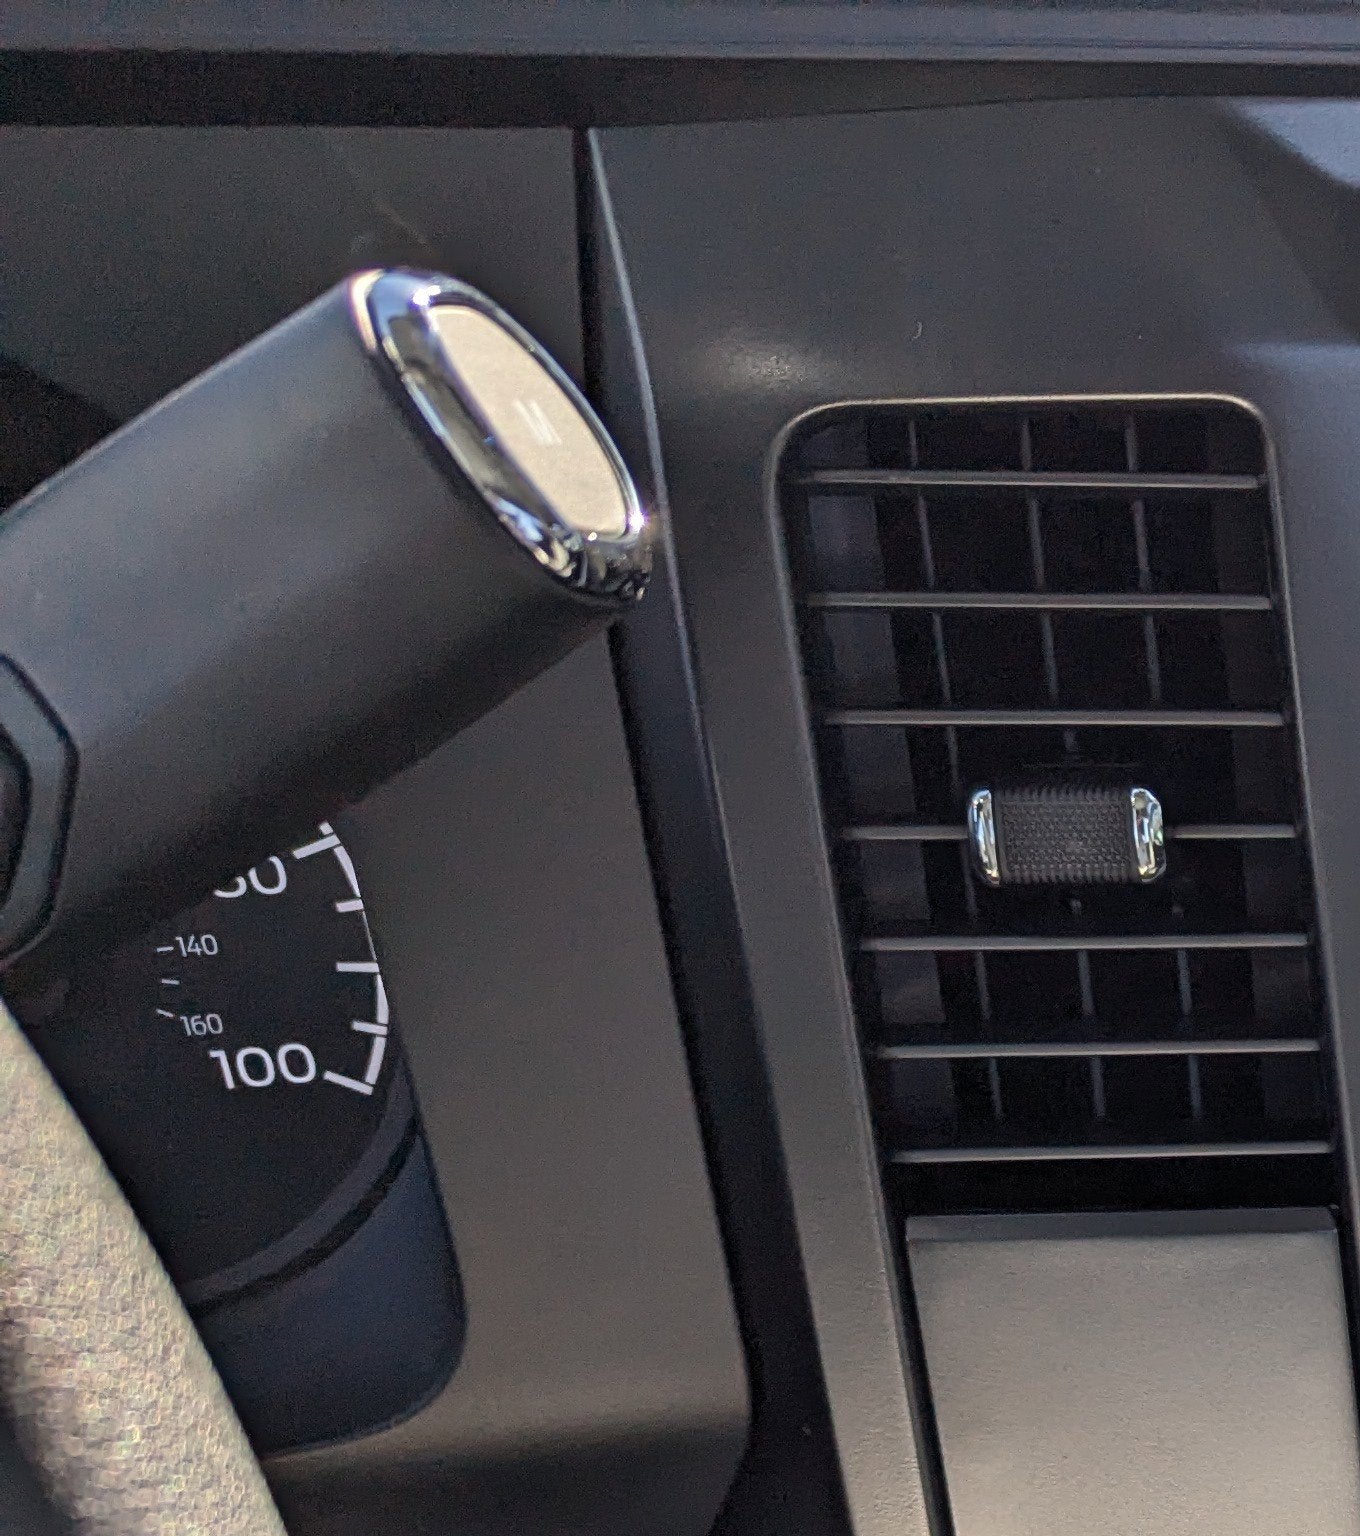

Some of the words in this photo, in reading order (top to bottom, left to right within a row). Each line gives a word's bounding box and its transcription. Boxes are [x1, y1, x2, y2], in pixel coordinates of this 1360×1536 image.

[175, 933, 219, 958] 140
[179, 1012, 224, 1037] 160
[208, 1042, 317, 1090] 100
